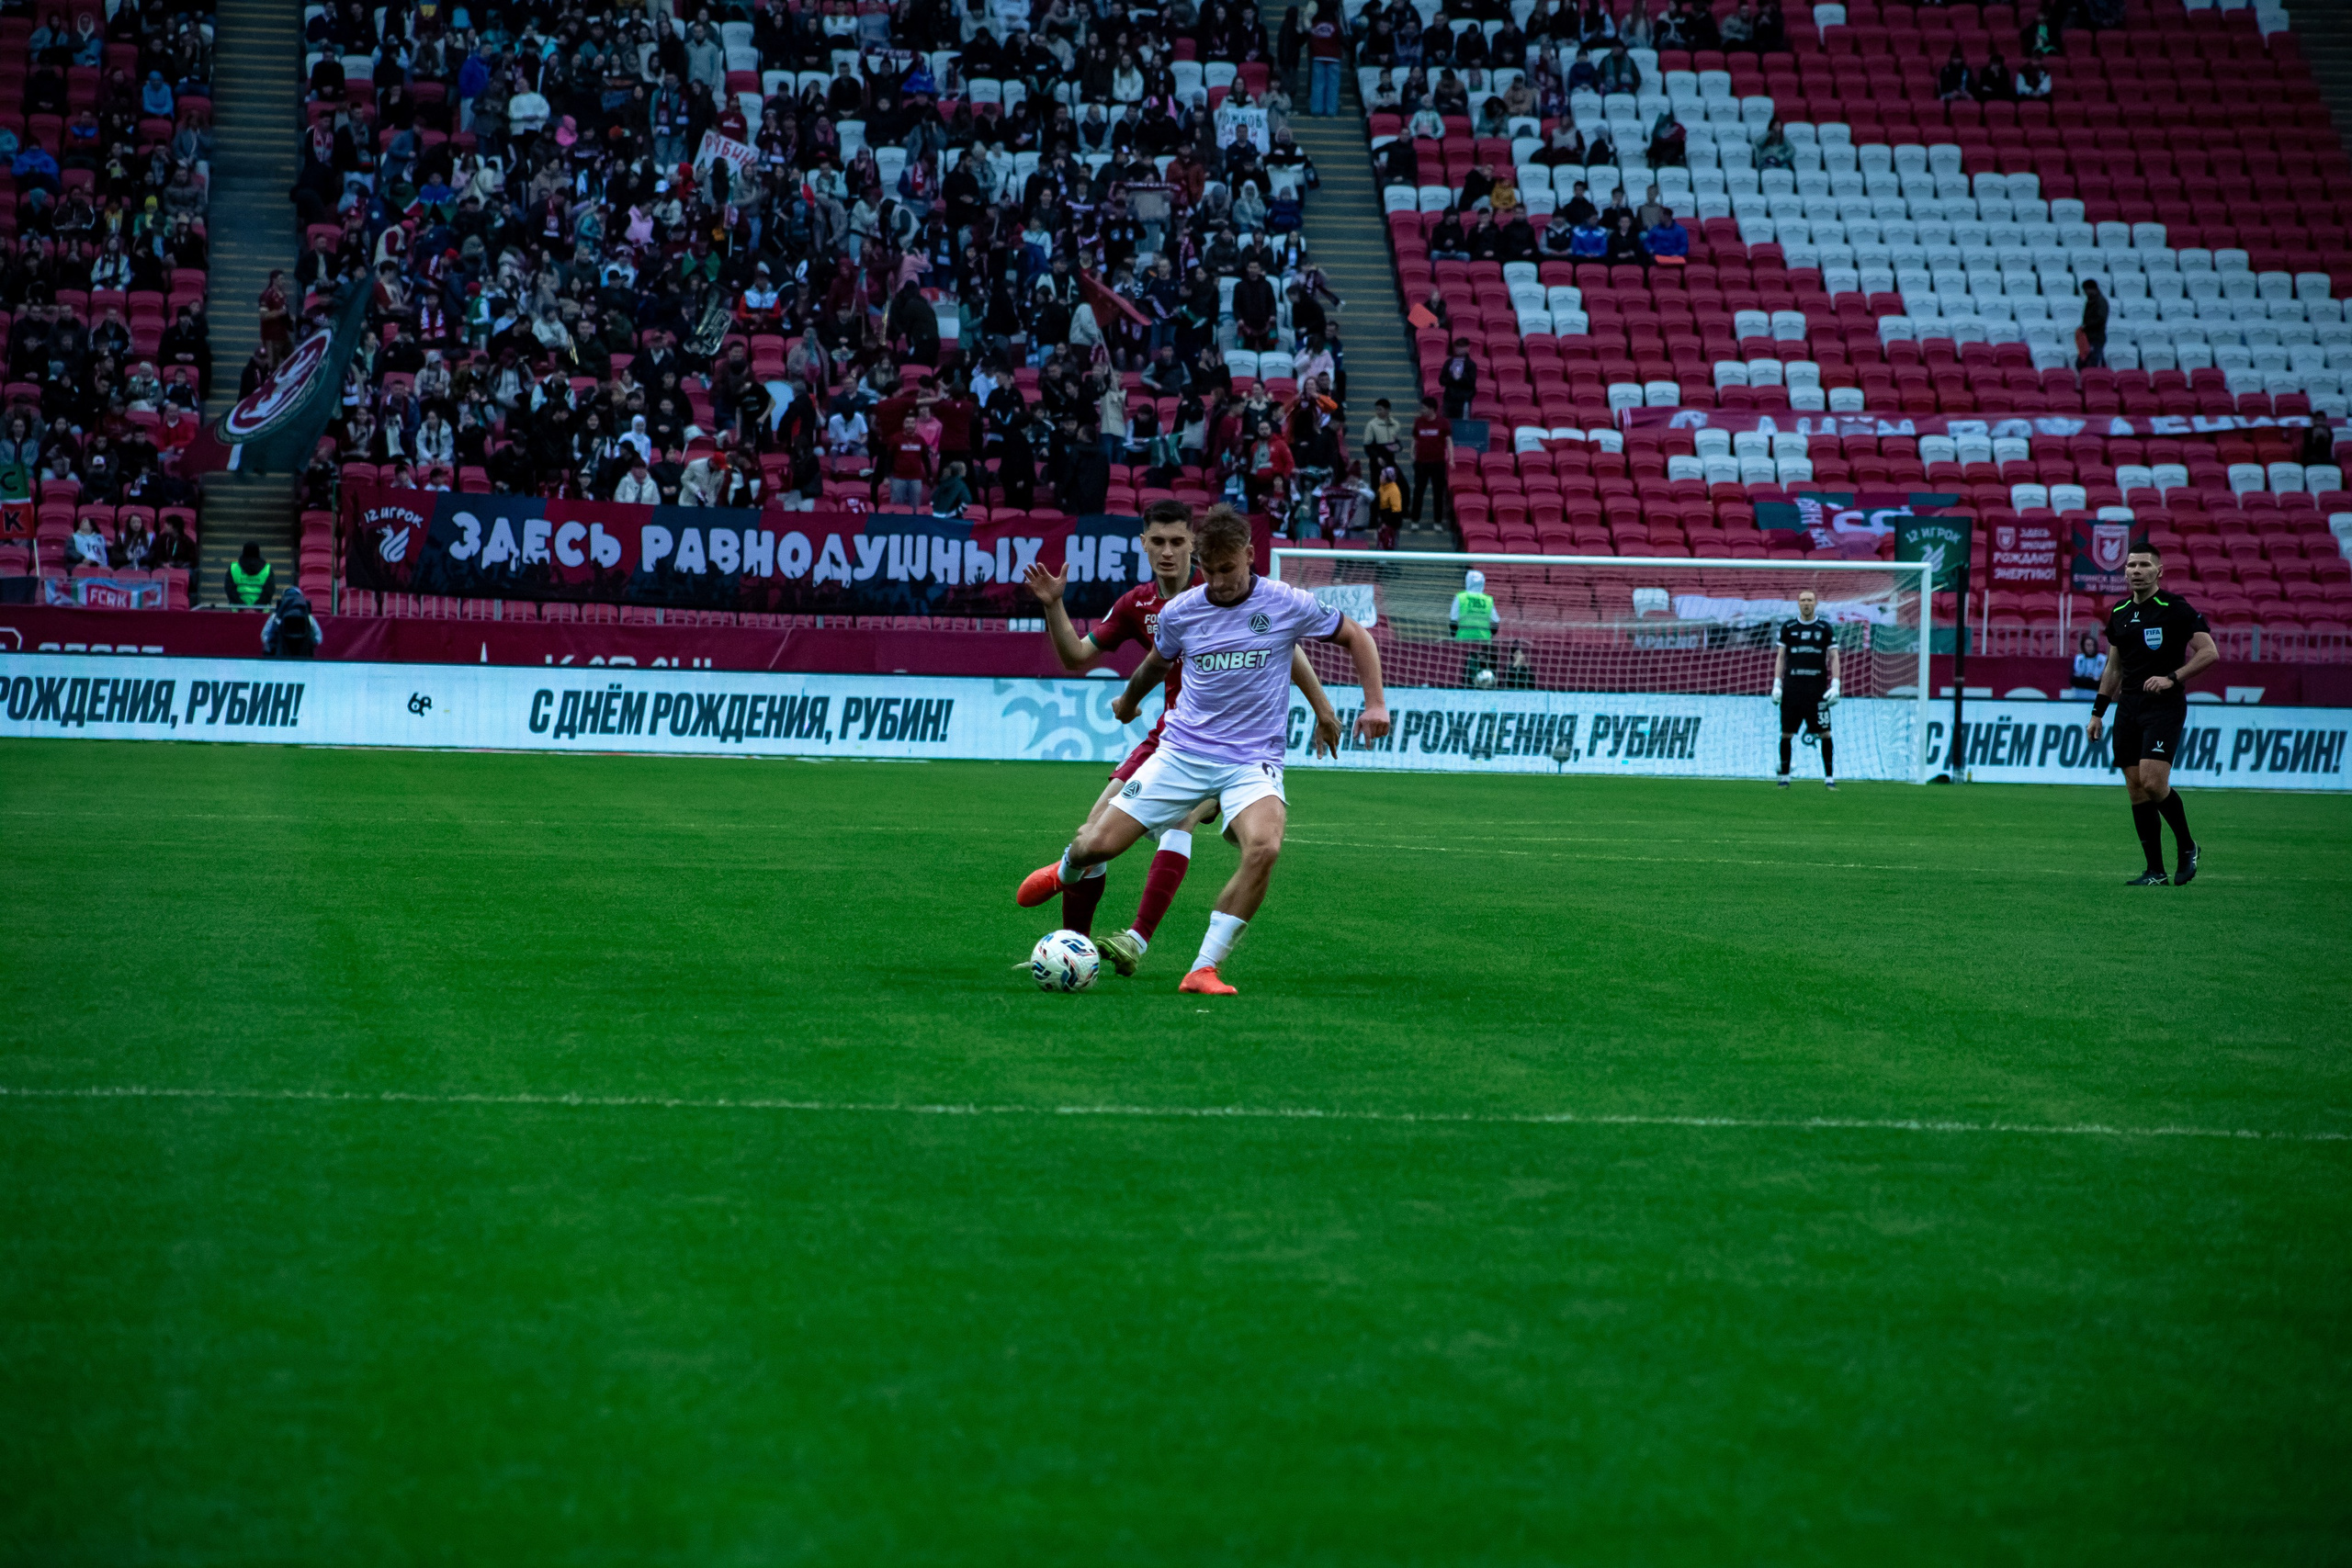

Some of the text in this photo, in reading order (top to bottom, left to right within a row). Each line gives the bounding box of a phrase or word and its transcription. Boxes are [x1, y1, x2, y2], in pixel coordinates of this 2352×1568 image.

[363, 505, 424, 528] 12 ИГРОК
[449, 512, 622, 571] ЗДЕСЬ
[640, 525, 1044, 589] РАВНОДУШНЫХ
[1144, 614, 1159, 625] FO
[1193, 649, 1272, 672] FONBET
[186, 681, 305, 728] РУБИН!
[529, 684, 955, 745] С ДНЁМ РОЖДЕНИЯ, РУБИН!
[1816, 711, 1829, 725] 38
[1399, 709, 1579, 761] РОЖДЕНИЯ,
[1587, 714, 1702, 760] РУБИН!
[2038, 725, 2222, 776] РОЖИЯ,
[2230, 728, 2347, 773] РУБИН!
